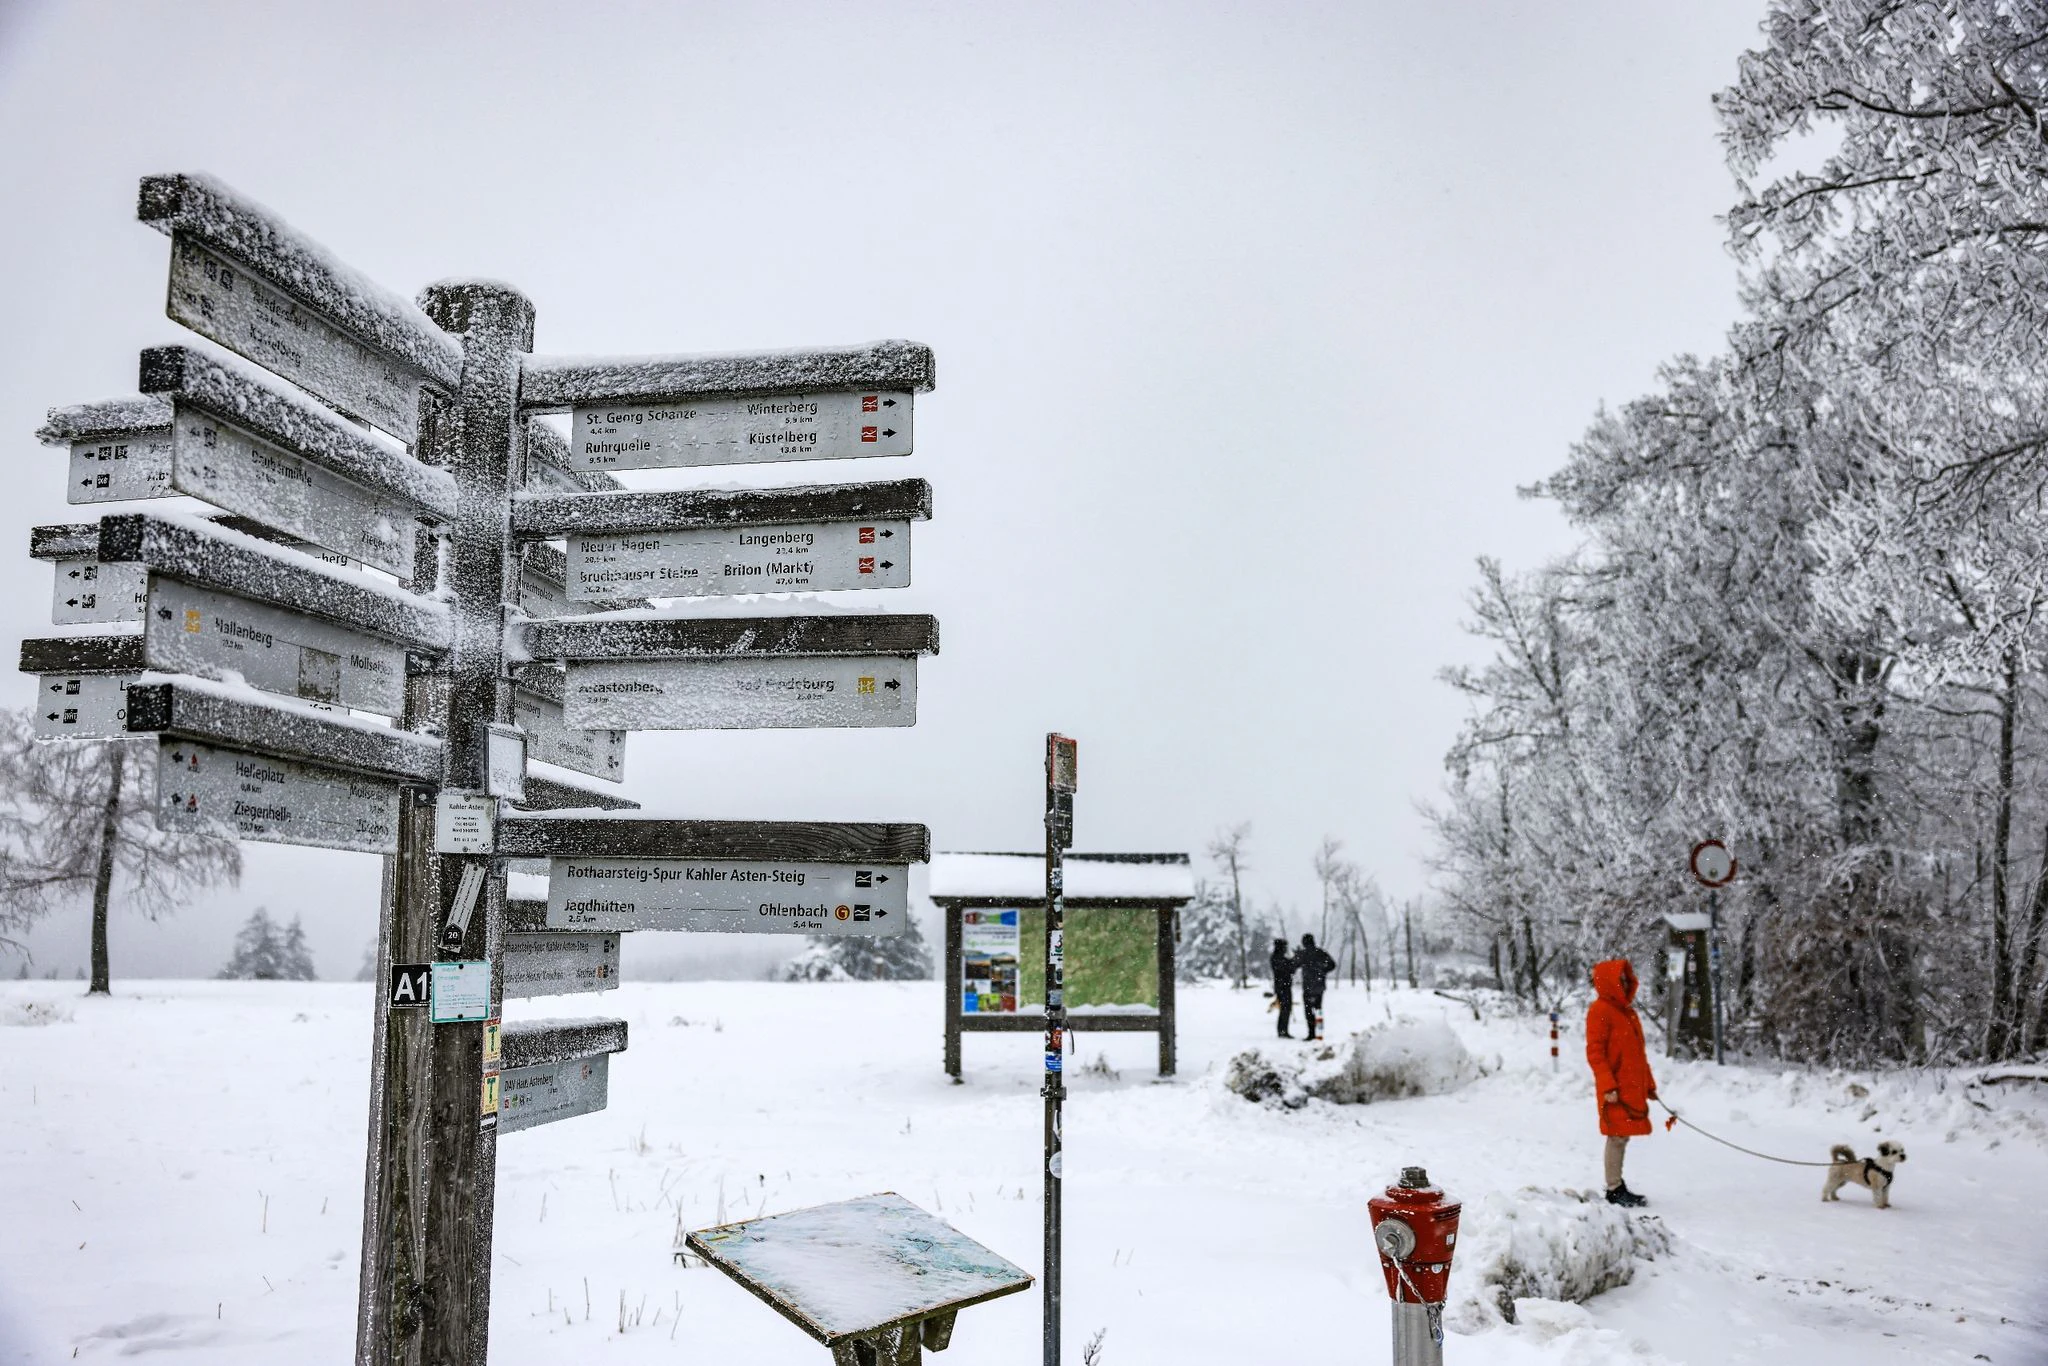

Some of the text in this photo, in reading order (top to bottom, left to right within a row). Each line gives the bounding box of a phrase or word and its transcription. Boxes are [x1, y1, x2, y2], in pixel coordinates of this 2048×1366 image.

[747, 401, 818, 415] Winterberg
[586, 409, 697, 425] St. Georg Schanze
[749, 431, 817, 445] Küstelberg
[585, 439, 651, 455] Ruhrquelle
[589, 456, 602, 464] 9,5
[580, 539, 660, 554] Neuer Hagen
[739, 531, 815, 548] Langenberg
[795, 546, 809, 554] km
[659, 566, 699, 580] Steine
[723, 560, 815, 577] Brilon (Markt)
[795, 577, 809, 585] km
[214, 617, 274, 649] Hallenberg
[235, 760, 286, 785] Helleplatz
[234, 800, 292, 823] Ziegenhelle
[567, 865, 806, 886] Rothaarsteig-Spur Kahler Asten-Steig
[563, 899, 636, 914] Jagdhütten
[758, 903, 828, 918] Ohlenbach
[568, 915, 597, 924] 2,5 km
[793, 920, 823, 929] 5,4 km
[447, 931, 458, 939] 20
[393, 971, 428, 1001] A1
